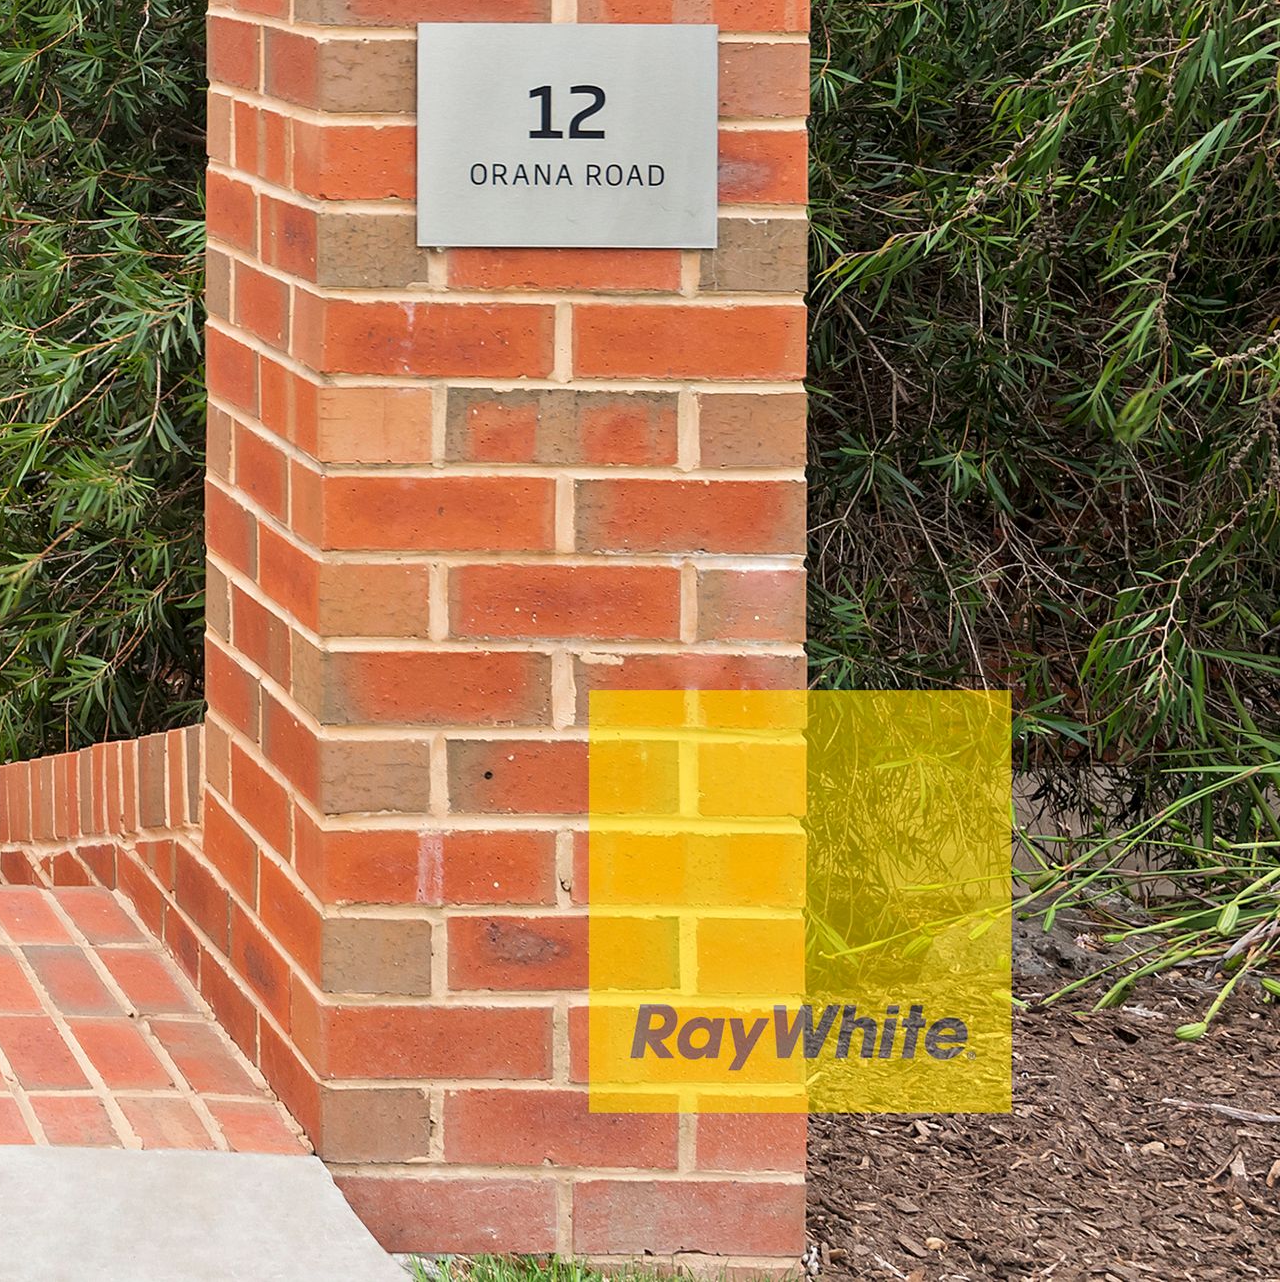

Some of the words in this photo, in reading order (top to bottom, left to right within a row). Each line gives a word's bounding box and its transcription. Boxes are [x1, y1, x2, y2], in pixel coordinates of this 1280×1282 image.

[530, 85, 605, 139] 12
[471, 164, 573, 185] ORANA
[587, 164, 664, 186] ROAD
